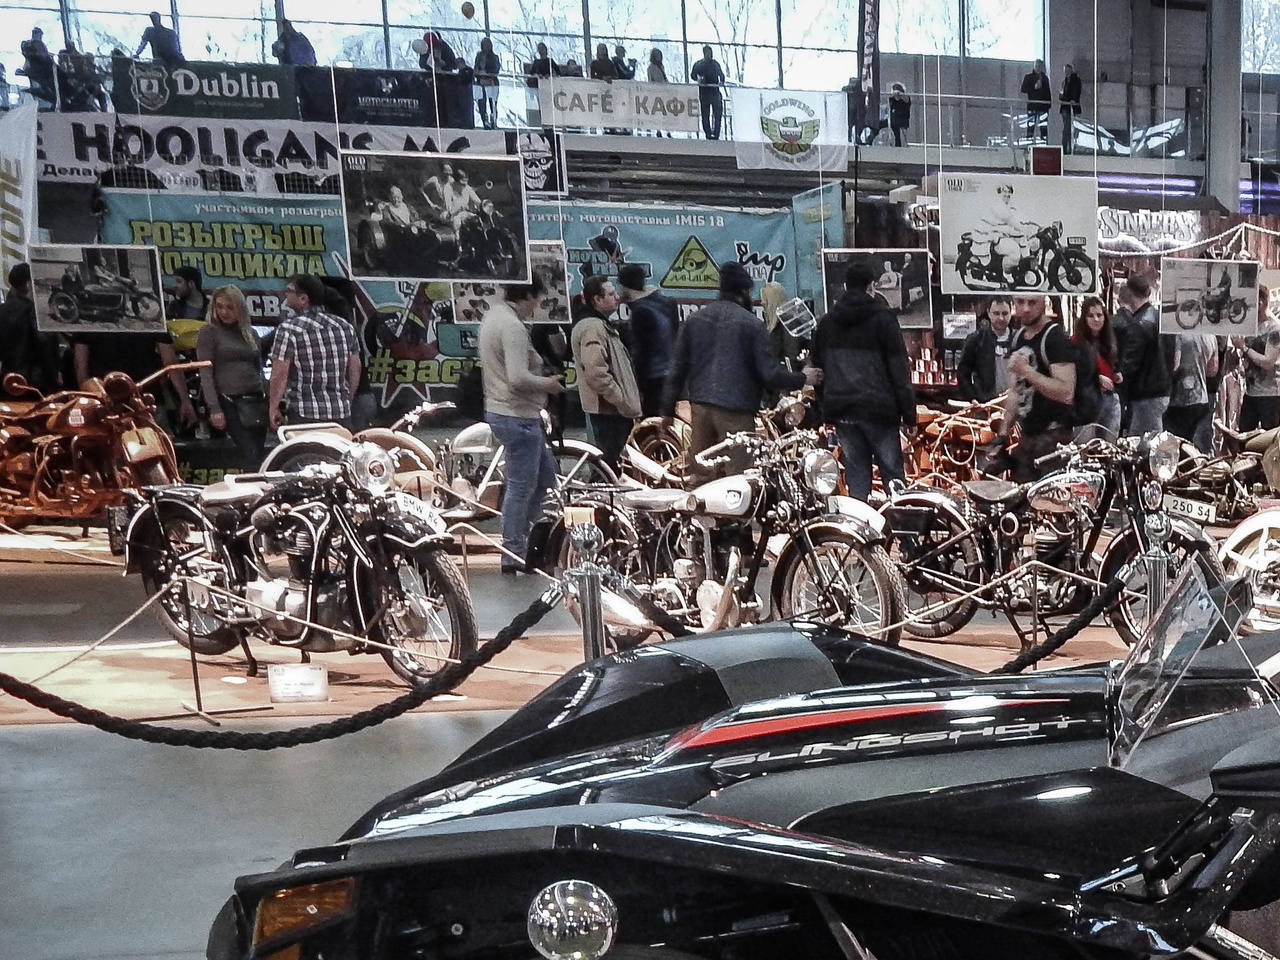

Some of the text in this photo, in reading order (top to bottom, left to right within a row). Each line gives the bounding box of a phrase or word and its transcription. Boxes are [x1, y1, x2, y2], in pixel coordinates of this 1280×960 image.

[172, 68, 280, 100] Dublin
[553, 90, 613, 114] CAFÉ
[634, 95, 699, 118] КАФЕ
[710, 215, 725, 228] 18
[130, 219, 326, 252] РОЗЫГРЫШ
[161, 250, 328, 280] ОТОЦИКЛА
[403, 496, 424, 514] BMW
[1172, 499, 1193, 514] 250
[710, 718, 1087, 771] SLINGSHOT
